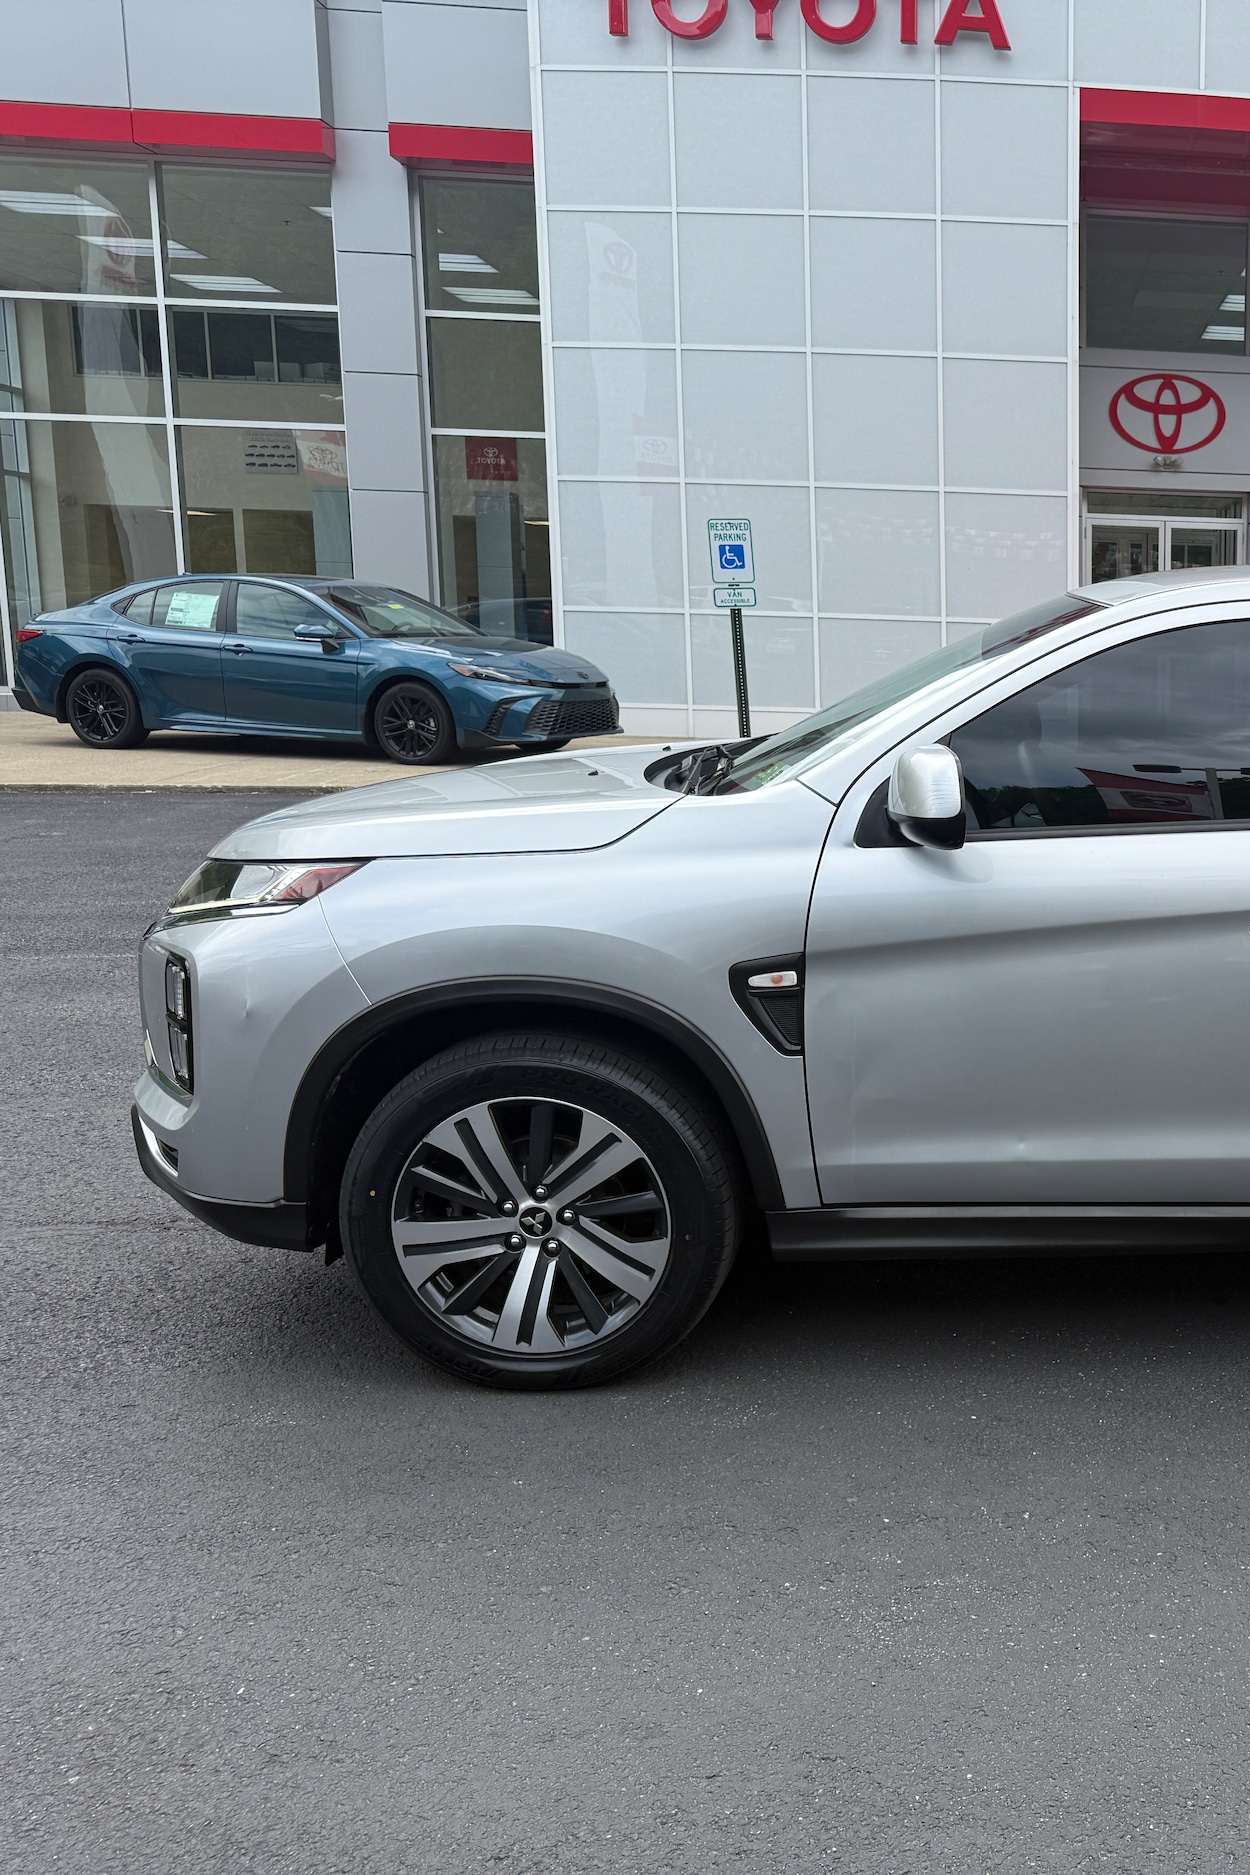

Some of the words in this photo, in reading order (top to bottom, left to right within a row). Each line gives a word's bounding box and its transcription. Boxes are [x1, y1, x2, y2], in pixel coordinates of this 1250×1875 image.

[477, 457, 506, 465] TOYOTA
[710, 522, 749, 532] RESERVED
[714, 533, 747, 542] PARKING
